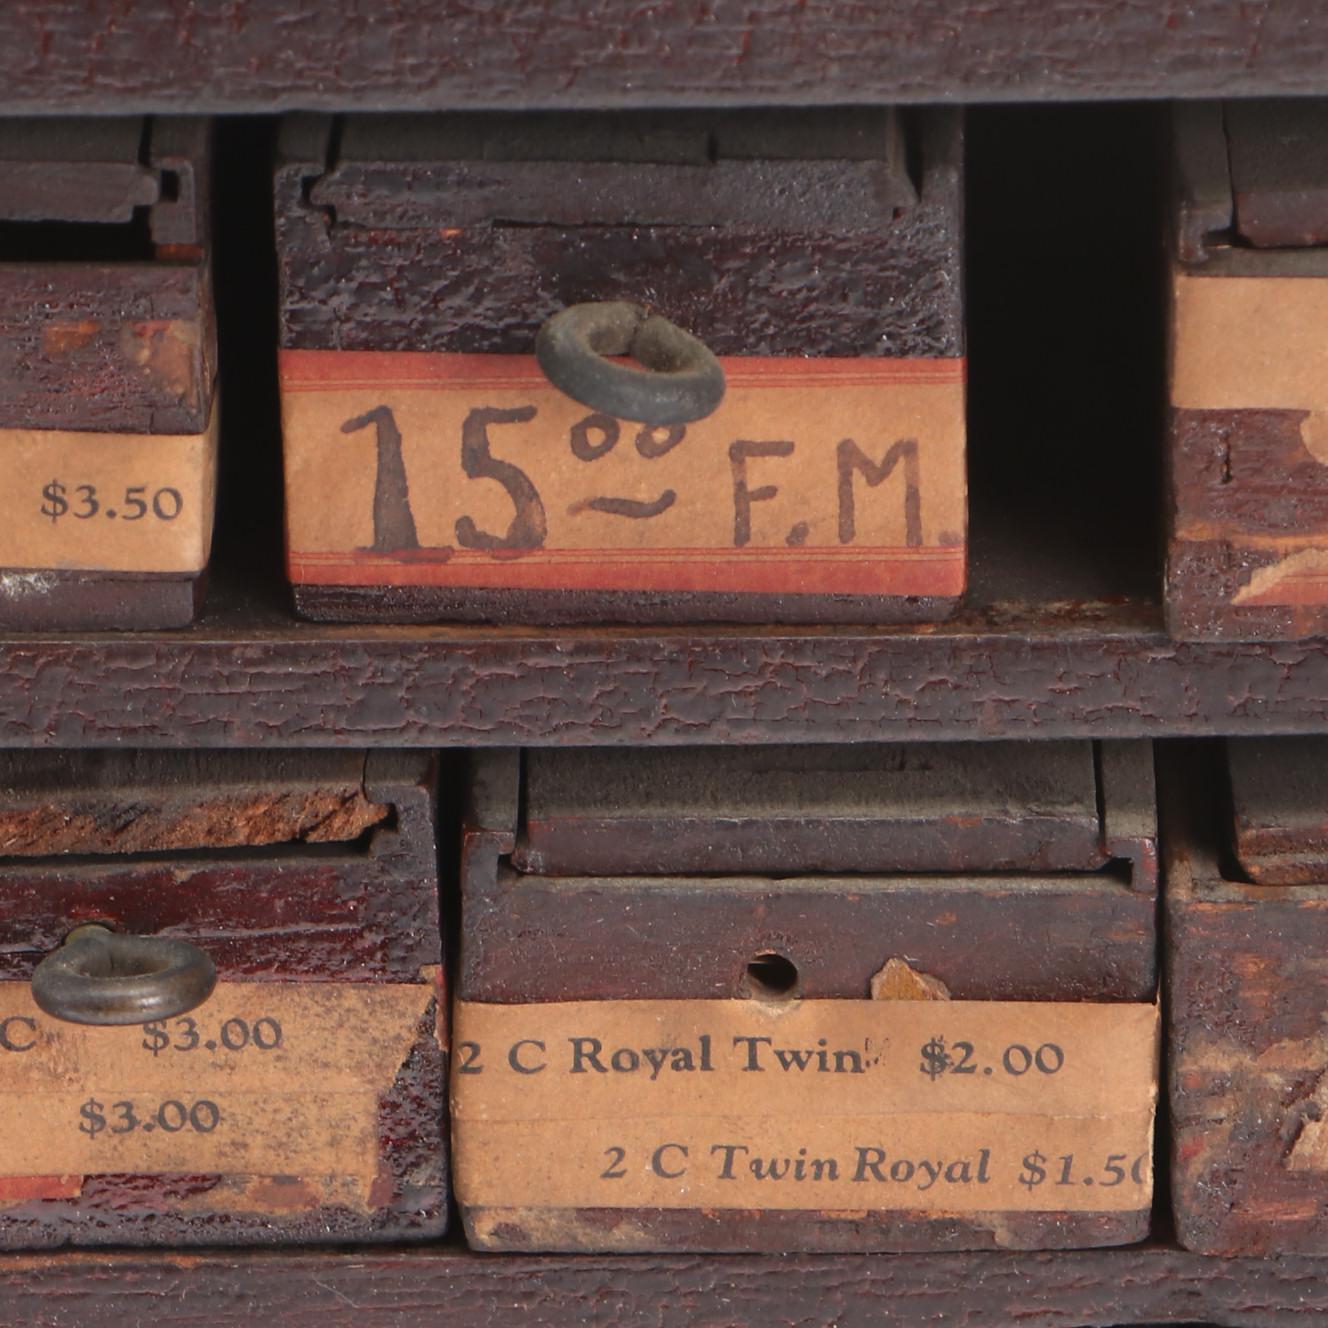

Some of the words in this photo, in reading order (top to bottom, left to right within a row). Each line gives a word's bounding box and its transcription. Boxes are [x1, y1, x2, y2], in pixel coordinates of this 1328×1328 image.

[40, 478, 183, 524] $3.50
[140, 1014, 284, 1058] $3.00
[458, 1040, 483, 1075] 2
[507, 1039, 547, 1076] C
[567, 1034, 715, 1081] Royal
[732, 1036, 867, 1074] Twin
[919, 1034, 1065, 1082] $2.00
[78, 1097, 225, 1141] $3.00
[599, 1146, 628, 1180] 2
[651, 1143, 689, 1180] C
[709, 1144, 840, 1182] Twin
[850, 1146, 991, 1192] Royal
